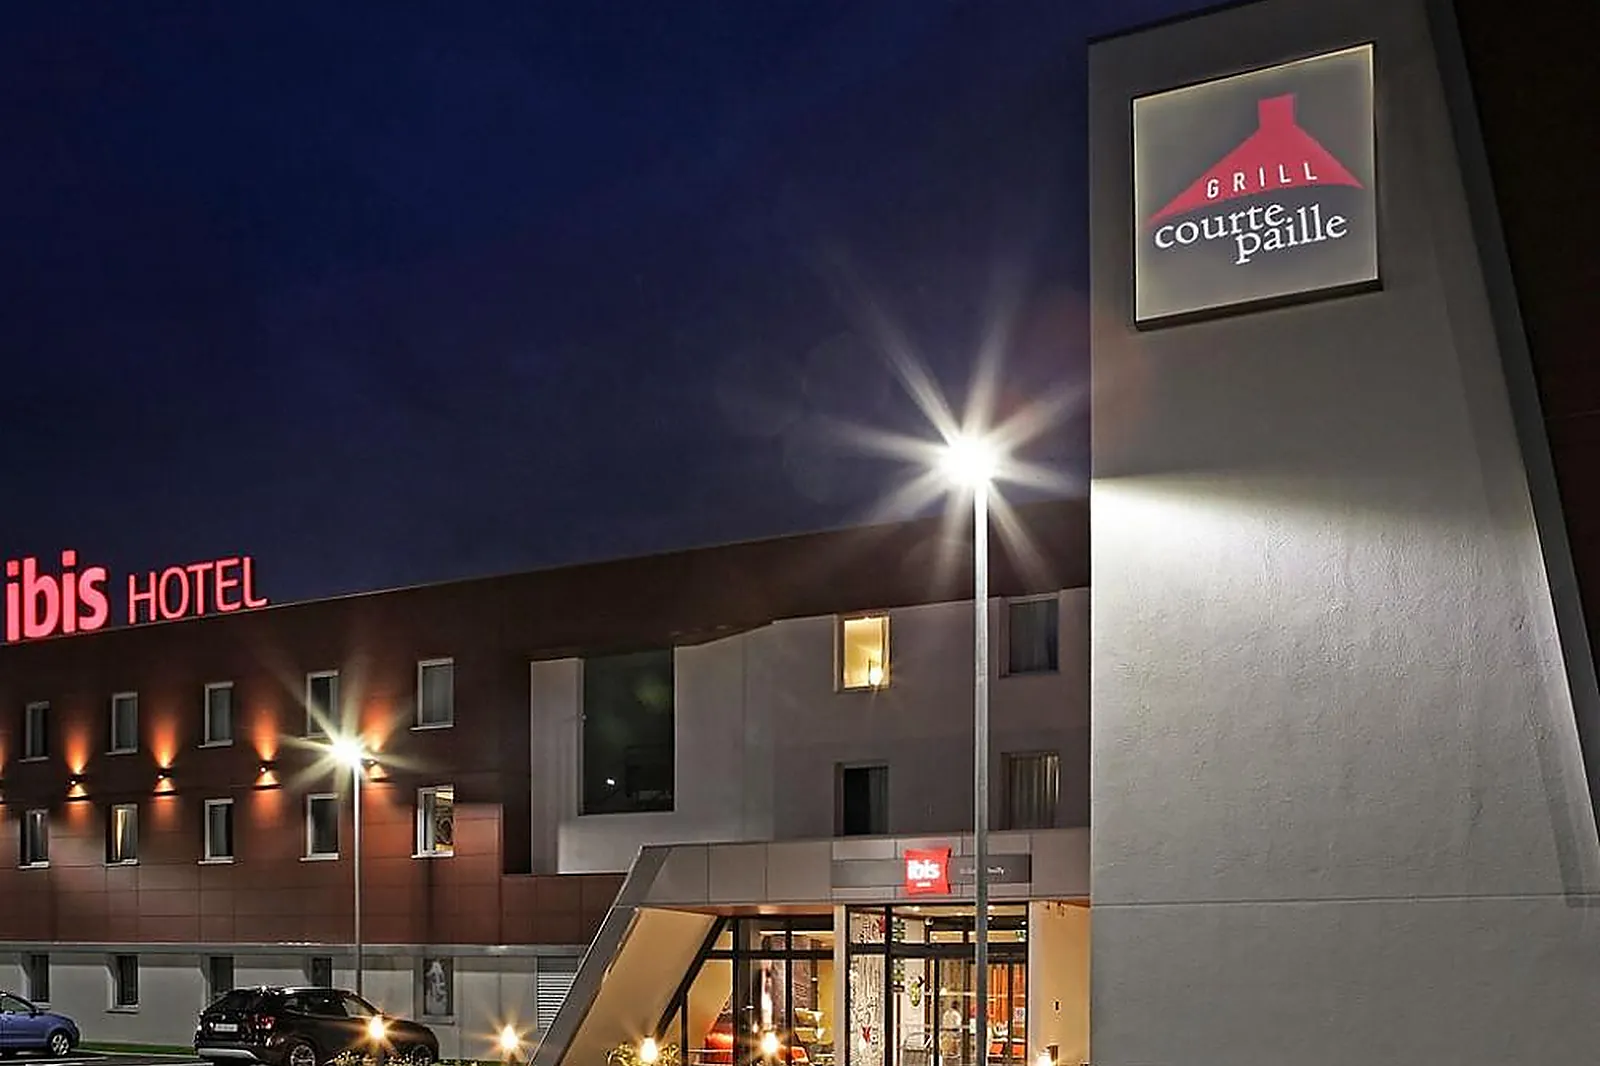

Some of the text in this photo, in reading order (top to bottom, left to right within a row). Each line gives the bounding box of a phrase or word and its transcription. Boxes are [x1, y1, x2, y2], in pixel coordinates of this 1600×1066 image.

[1206, 162, 1318, 199] GRILL
[1154, 203, 1285, 249] courte
[1235, 203, 1348, 265] paille
[6, 549, 268, 642] ibis HOTEL
[907, 859, 941, 880] ibis
